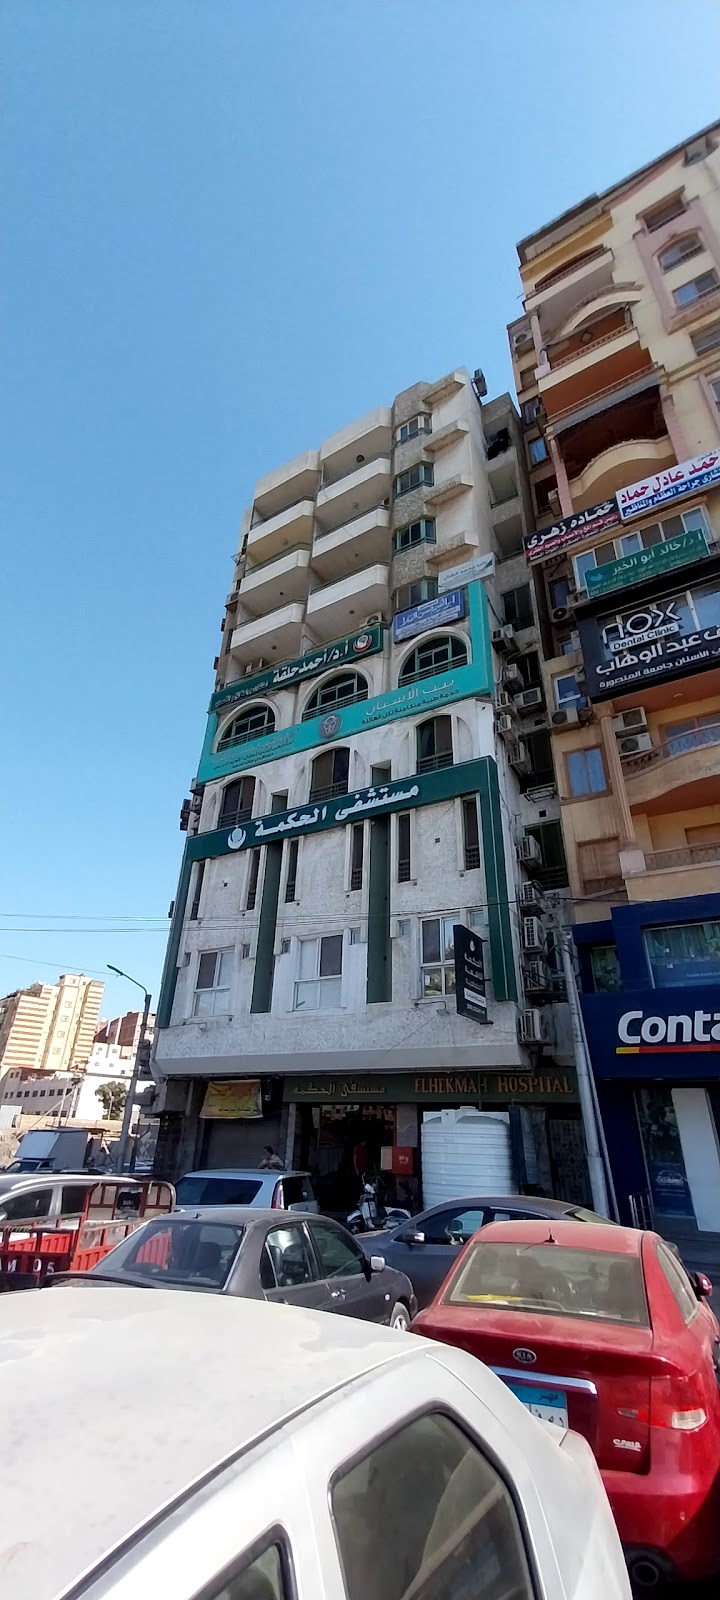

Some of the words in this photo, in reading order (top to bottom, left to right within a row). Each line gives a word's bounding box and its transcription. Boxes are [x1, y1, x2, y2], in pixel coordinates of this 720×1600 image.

[613, 635, 645, 650] Dental
[647, 625, 676, 639] Clinic
[666, 634, 701, 653] عبد
[596, 643, 664, 675] الوهاب
[334, 785, 420, 821] مستشفى
[254, 806, 328, 837] الحكمة
[341, 1081, 386, 1099] مستشفى
[414, 1077, 488, 1094] ELHEKMAH
[497, 1076, 573, 1094] HOSPITAL
[515, 1351, 533, 1360] KIA
